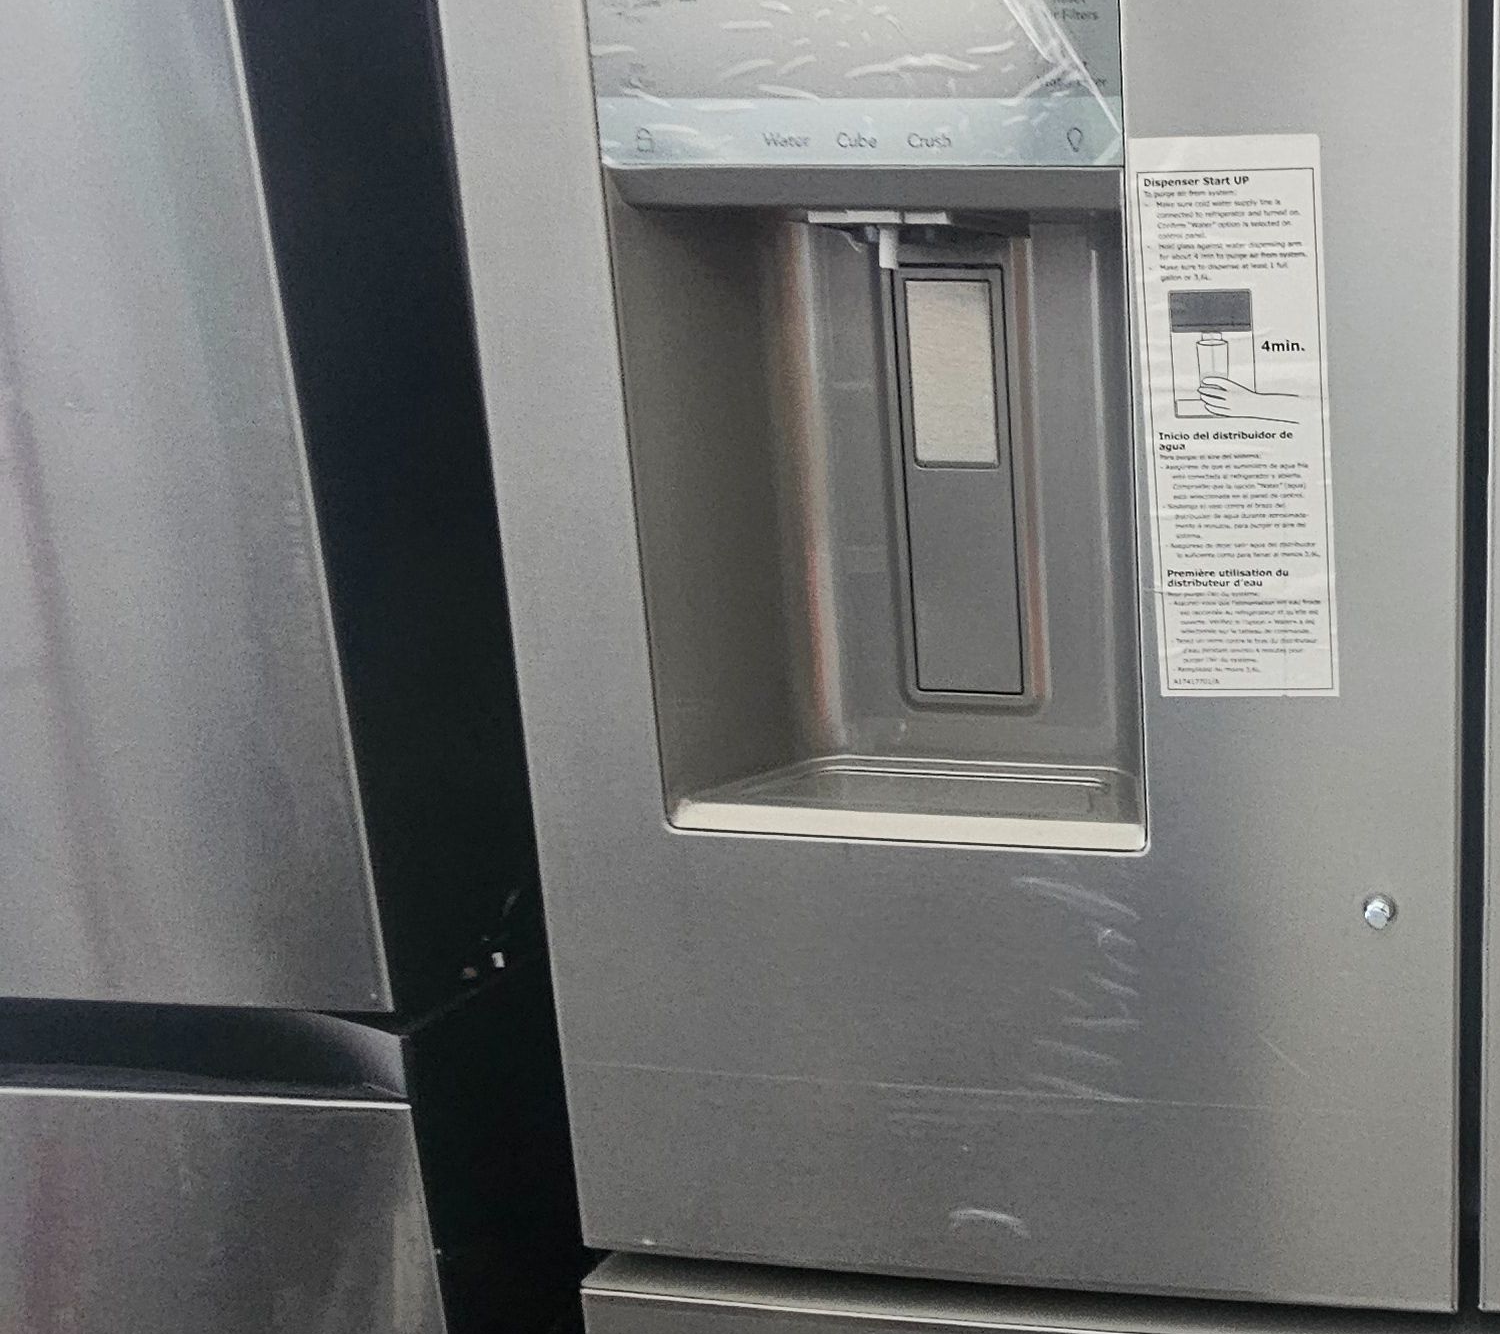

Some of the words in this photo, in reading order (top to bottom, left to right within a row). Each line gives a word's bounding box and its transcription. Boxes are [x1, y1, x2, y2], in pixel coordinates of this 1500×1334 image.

[1063, 8, 1099, 21] Filters
[762, 131, 810, 148] Water
[836, 132, 877, 148] Cube
[907, 132, 951, 148] Crush
[1144, 178, 1200, 188] Dispenser
[1202, 177, 1230, 186] Start
[1233, 176, 1250, 185] UP
[1261, 339, 1305, 352] 4min.
[1158, 431, 1190, 441] Inicio
[1193, 431, 1209, 440] del
[1212, 430, 1276, 440] distribuidor
[1279, 430, 1293, 440] de
[1159, 442, 1186, 452] agua
[1167, 568, 1216, 578] Première
[1218, 568, 1273, 577] utilisation
[1275, 568, 1289, 577] du
[1167, 579, 1231, 588] distributeur
[1234, 578, 1263, 588] d'eau
